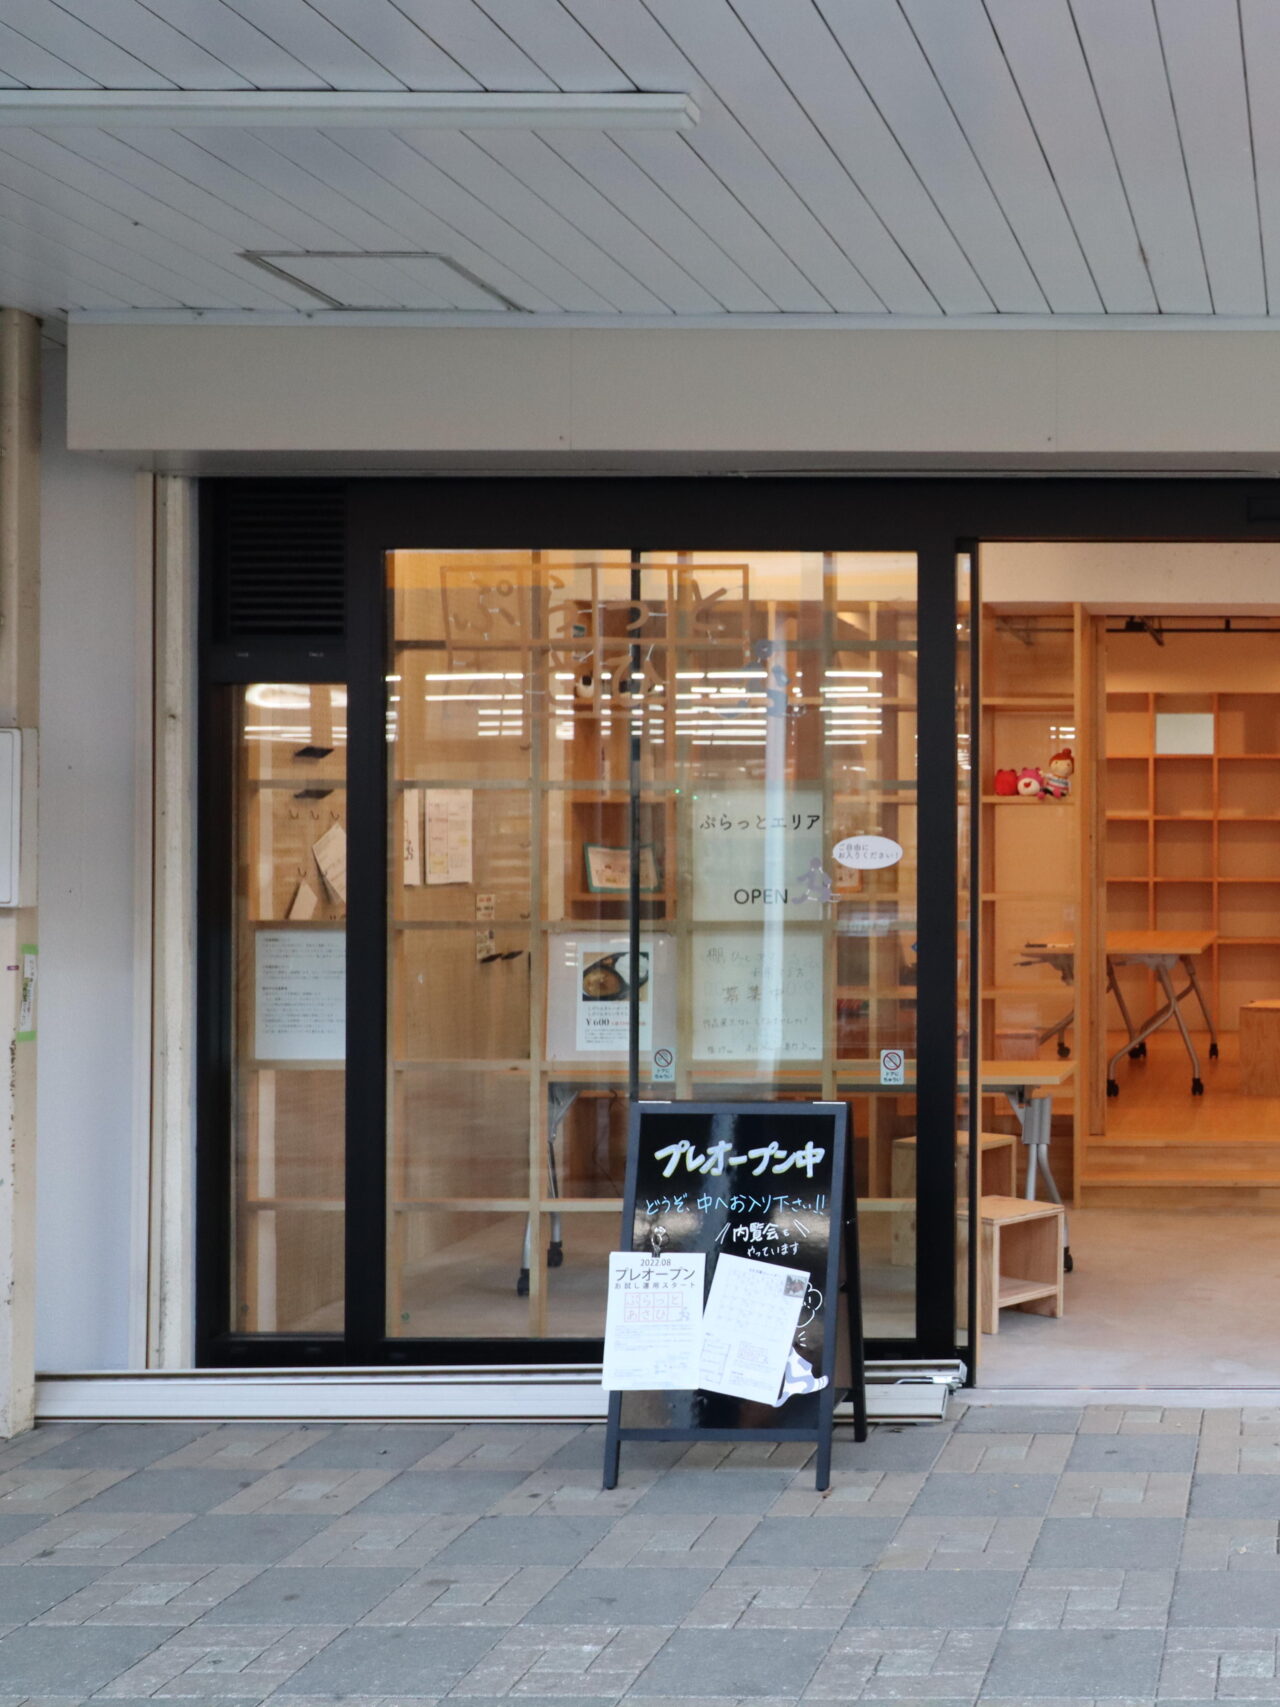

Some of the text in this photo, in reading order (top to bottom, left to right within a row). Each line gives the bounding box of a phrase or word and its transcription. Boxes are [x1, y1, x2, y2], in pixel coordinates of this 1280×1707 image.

[700, 813, 821, 831] ぷらっとエリア
[733, 888, 788, 905] OPEN
[654, 1140, 825, 1178] プレオープン中
[747, 1242, 799, 1257] やっています
[640, 1258, 671, 1267] 2022.08
[615, 1267, 696, 1281] プレオープン
[615, 1281, 696, 1290] お試し運用スタート
